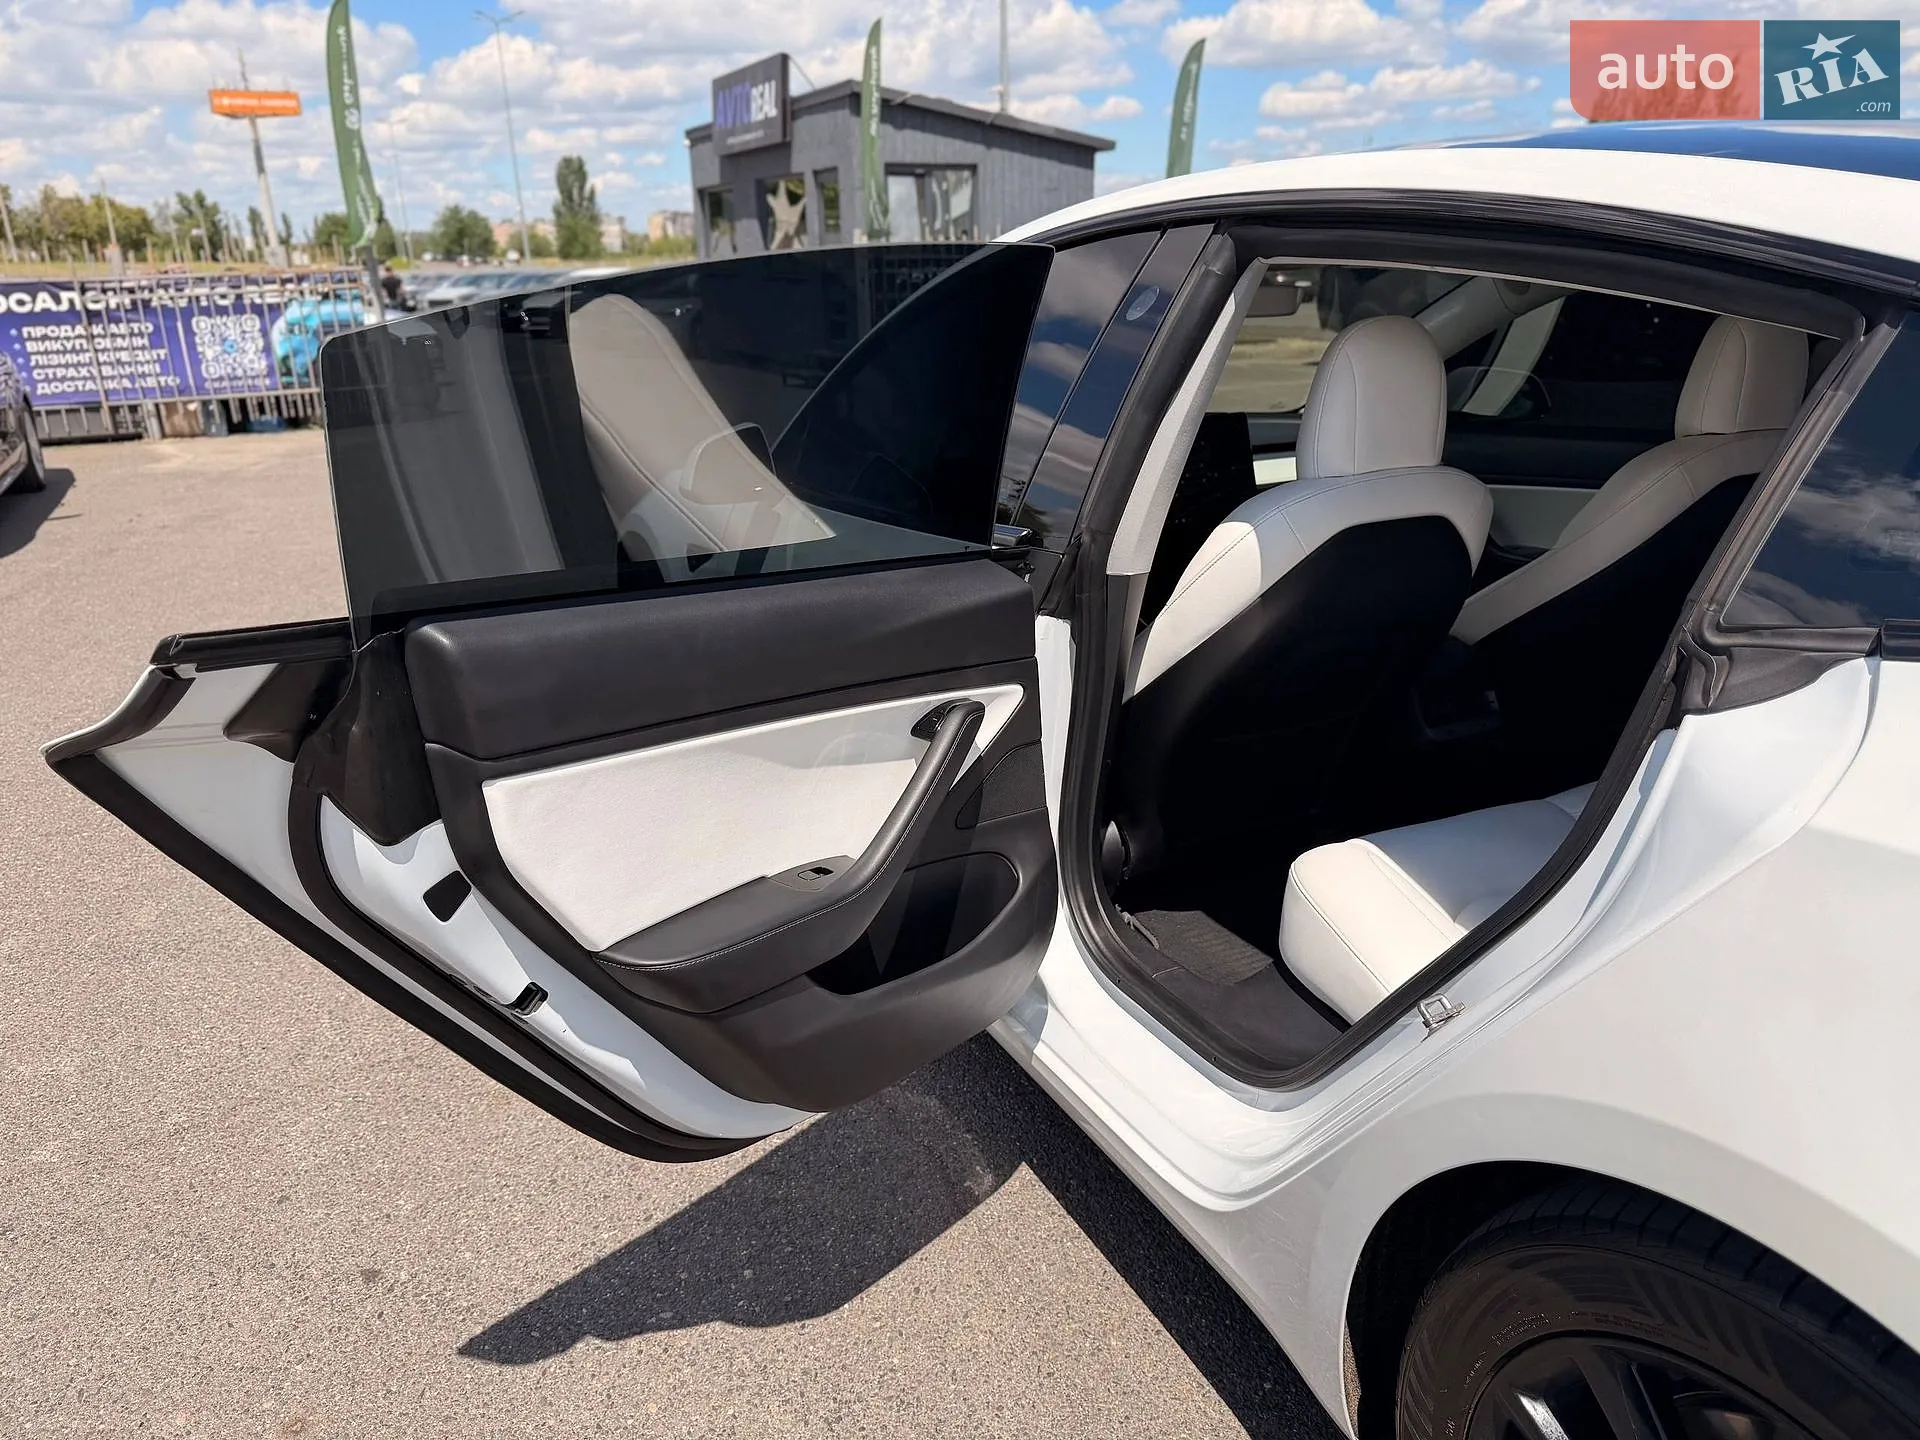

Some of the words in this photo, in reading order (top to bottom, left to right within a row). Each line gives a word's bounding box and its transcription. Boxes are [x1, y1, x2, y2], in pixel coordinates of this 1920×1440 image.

[108, 322, 154, 336] АВТО
[25, 337, 89, 353] ВИКУП
[29, 352, 93, 367] ЛІЗИНГ
